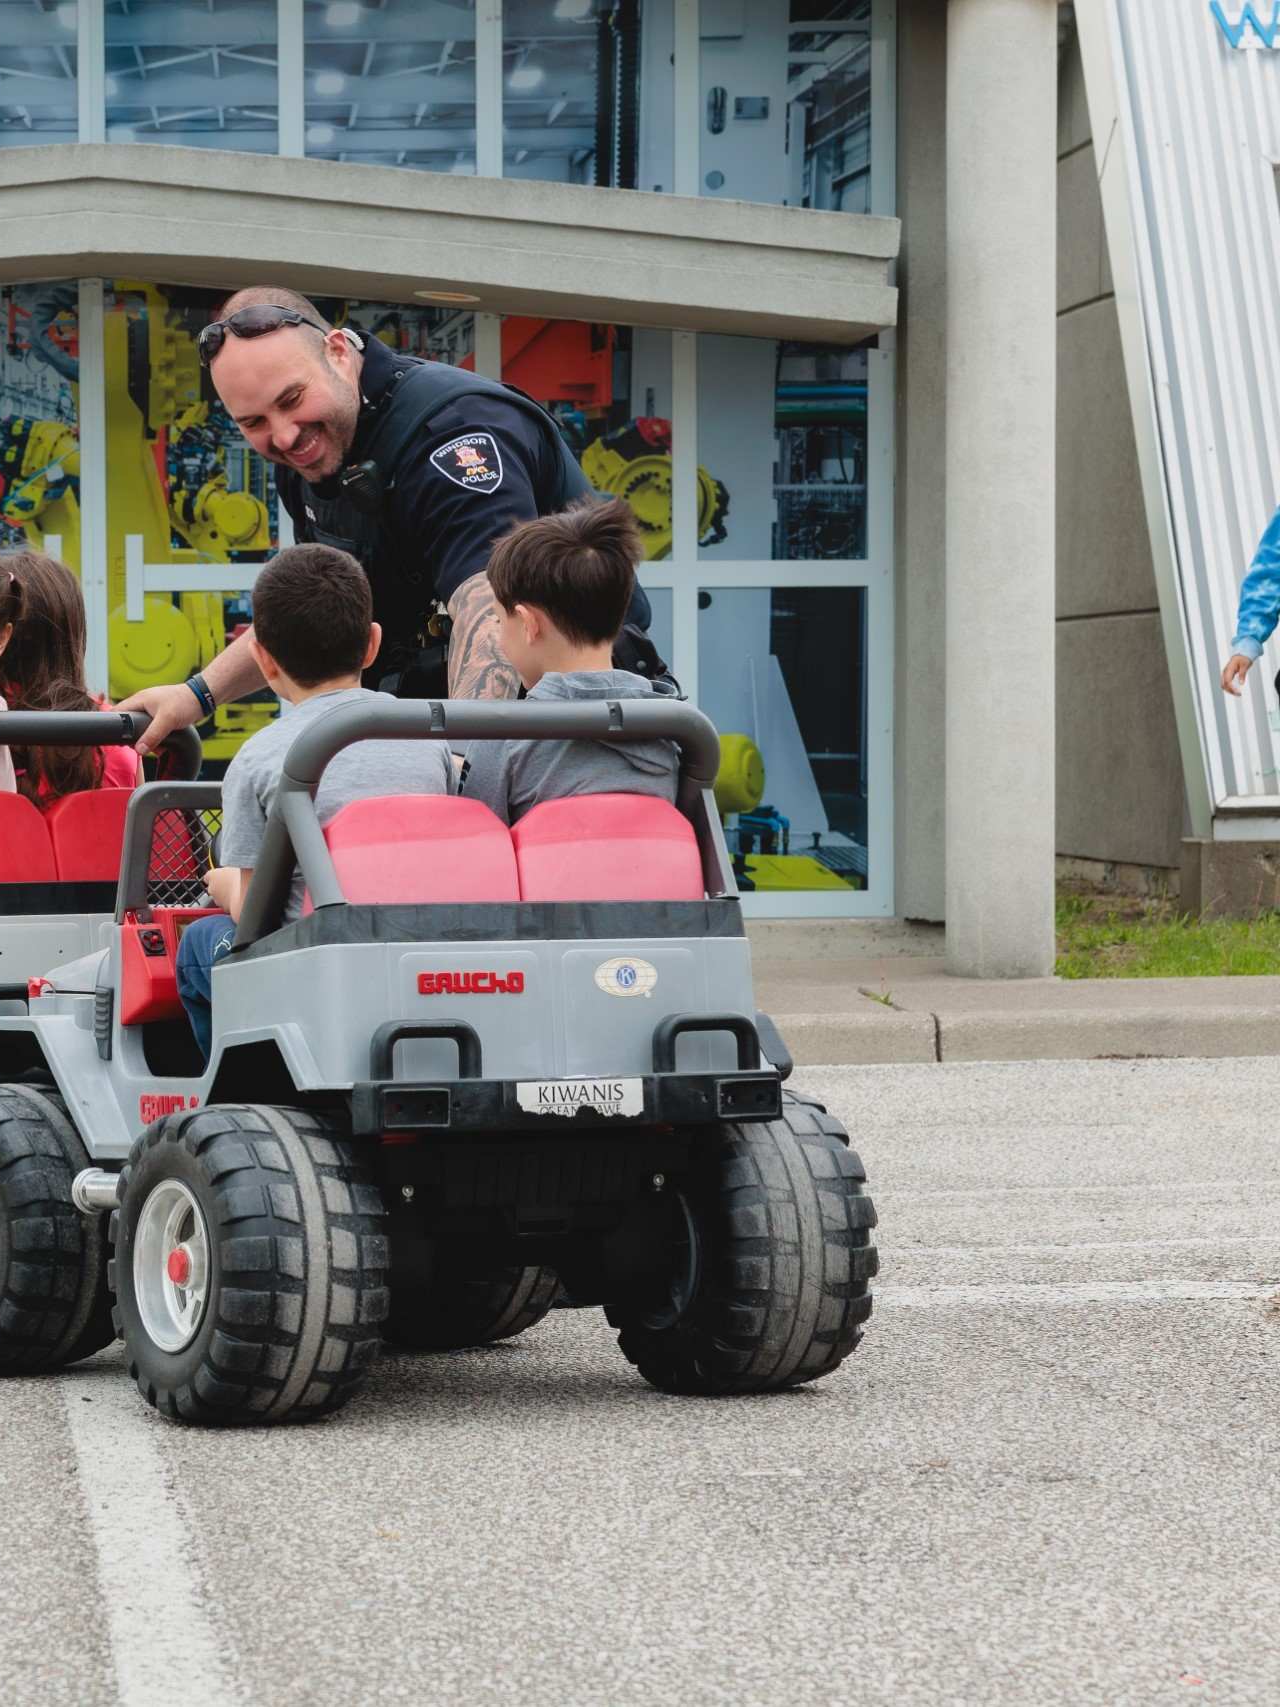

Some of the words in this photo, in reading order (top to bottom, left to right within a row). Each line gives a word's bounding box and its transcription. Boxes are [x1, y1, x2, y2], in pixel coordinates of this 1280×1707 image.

[436, 437, 487, 457] WINDSOR
[461, 471, 499, 484] POLICE
[538, 1083, 624, 1103] KIWANIS
